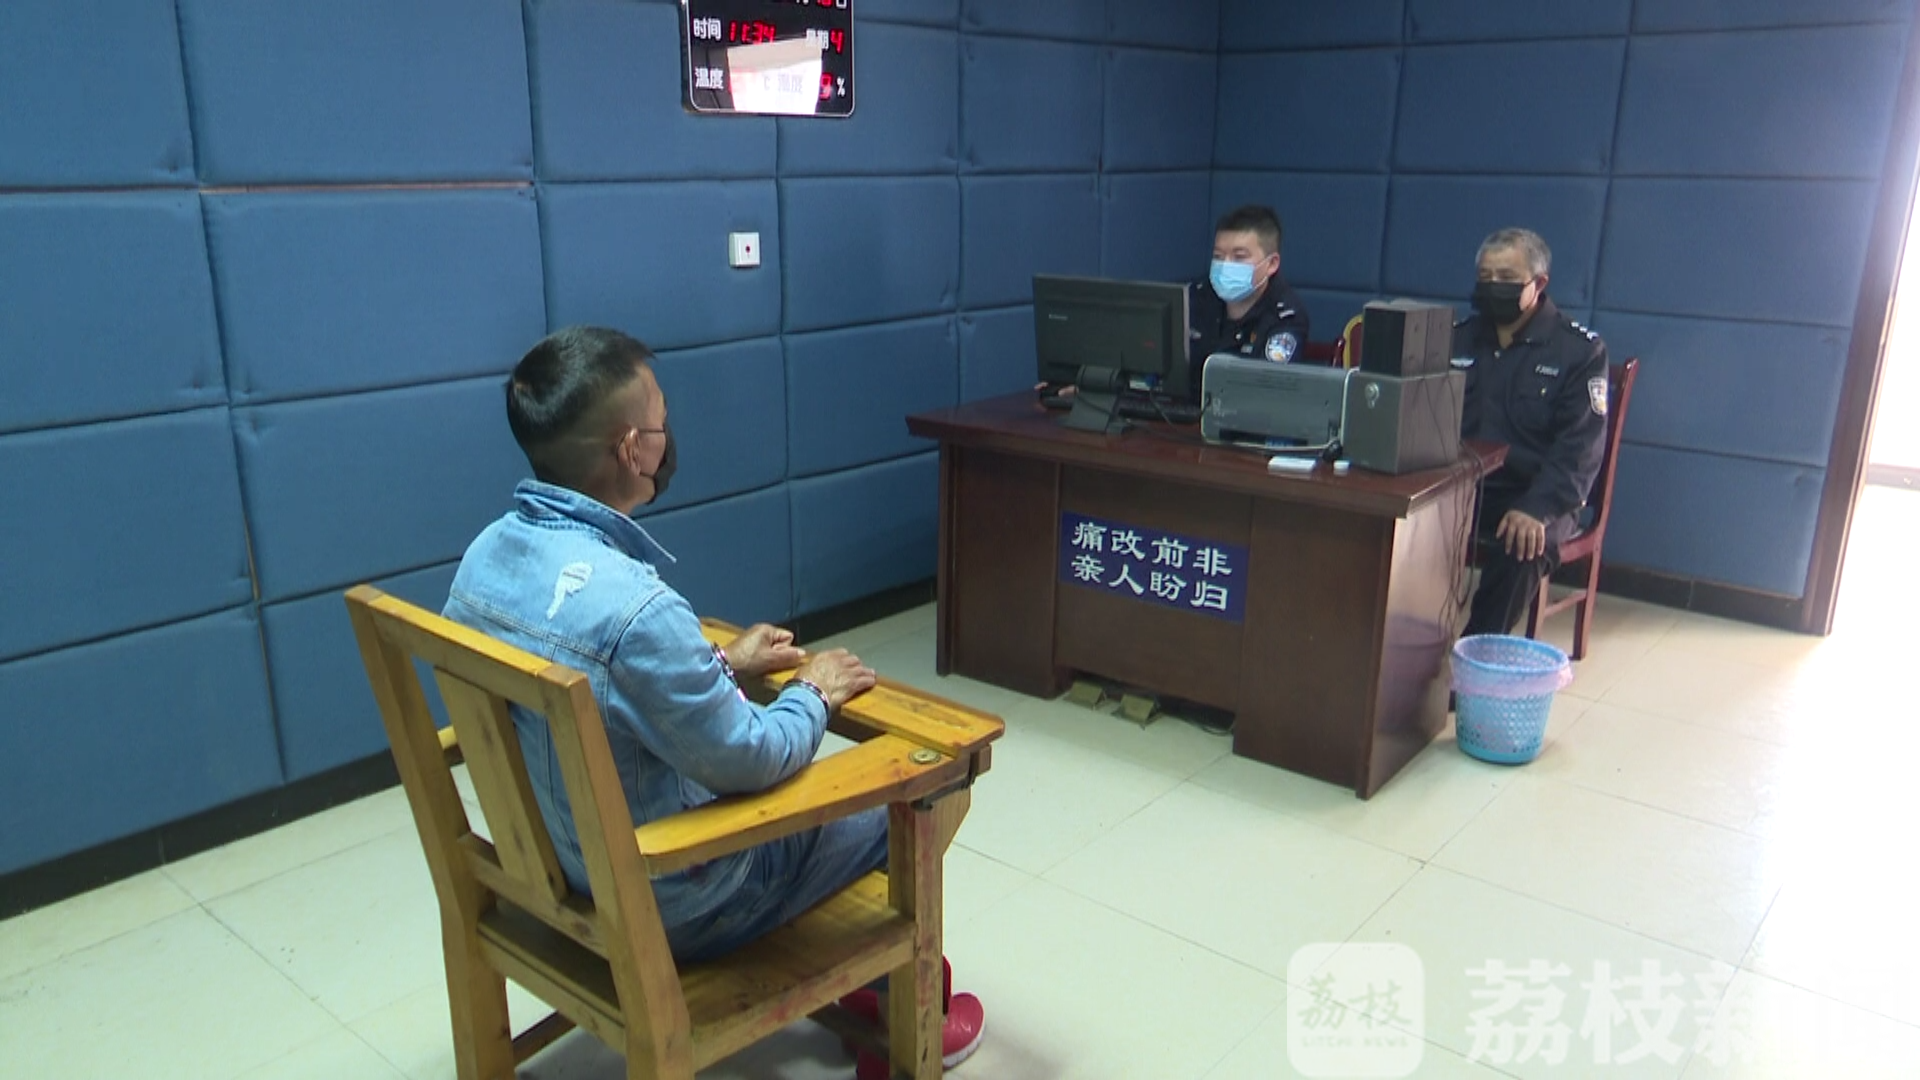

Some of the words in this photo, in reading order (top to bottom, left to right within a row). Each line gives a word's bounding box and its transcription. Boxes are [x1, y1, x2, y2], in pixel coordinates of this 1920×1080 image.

[693, 18, 722, 40] 时间
[694, 67, 724, 90] 温度
[1071, 521, 1232, 577] 痛改前非
[1071, 554, 1228, 611] 亲人盼归
